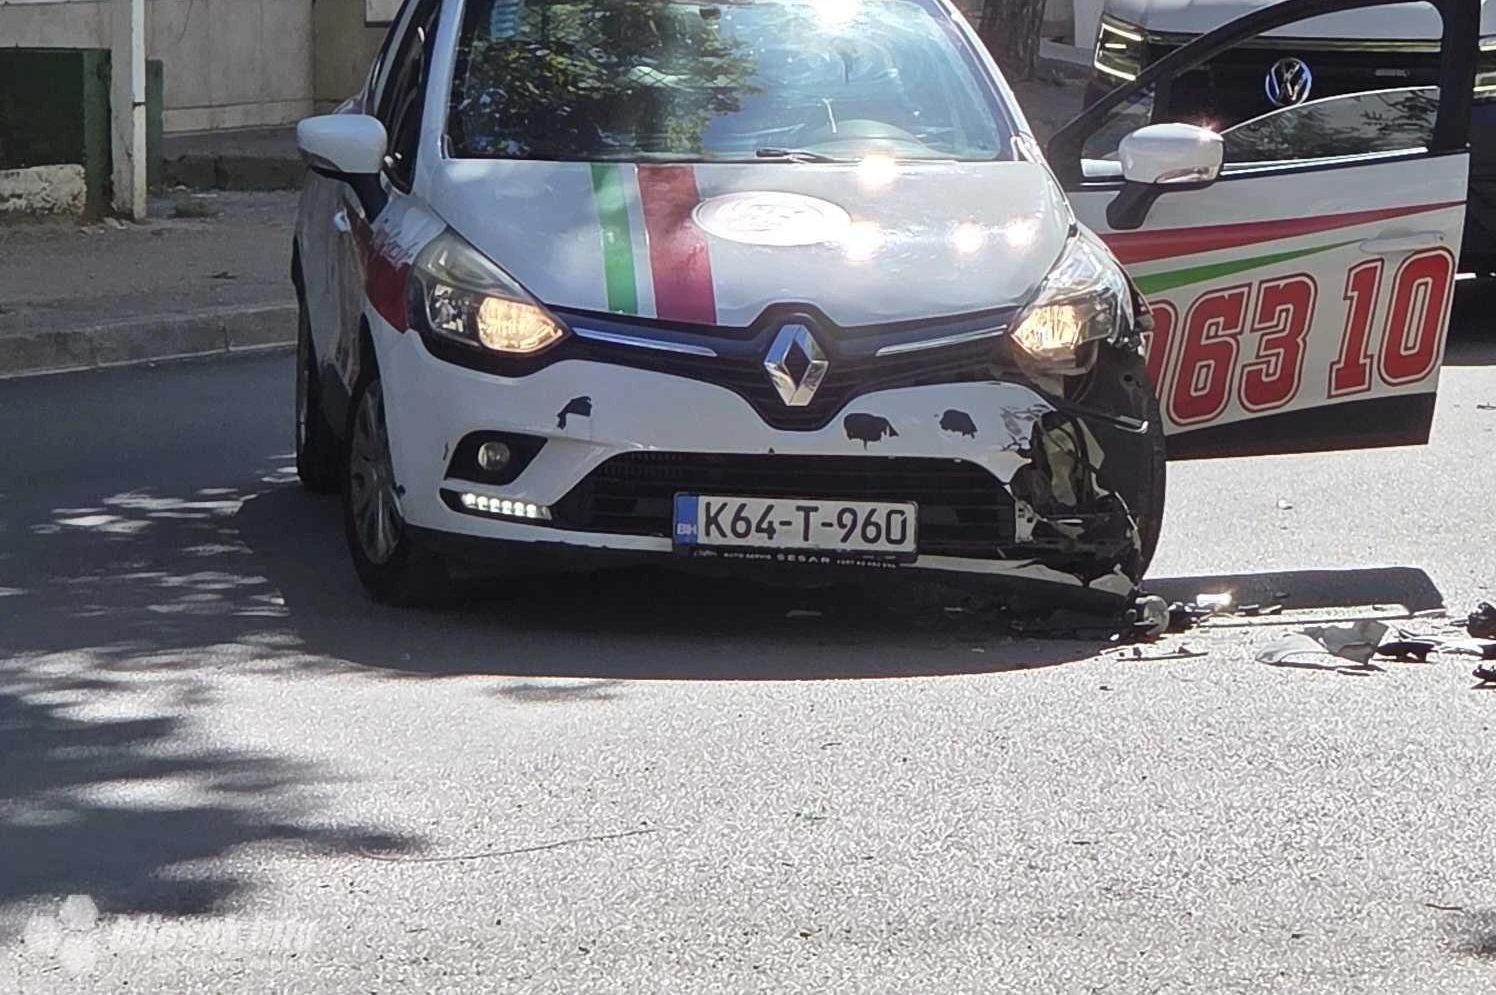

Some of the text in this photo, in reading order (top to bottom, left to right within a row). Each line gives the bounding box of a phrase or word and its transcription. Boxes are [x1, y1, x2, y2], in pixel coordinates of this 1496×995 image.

[1326, 245, 1456, 400] 10
[676, 523, 697, 536] BH
[703, 500, 908, 546] K64-T-960
